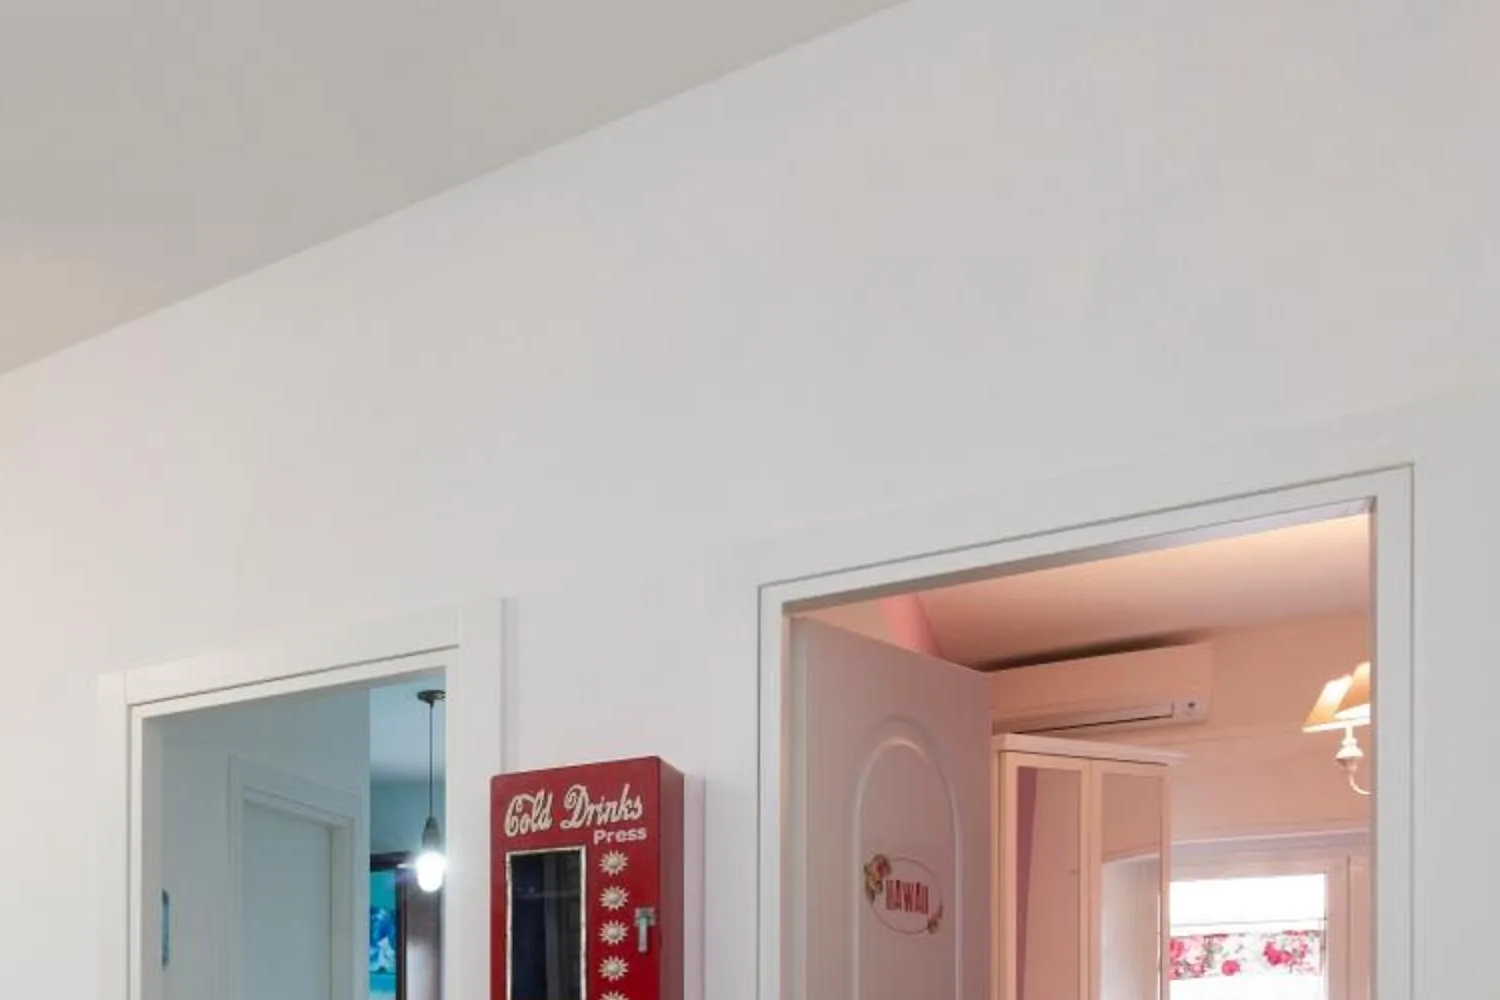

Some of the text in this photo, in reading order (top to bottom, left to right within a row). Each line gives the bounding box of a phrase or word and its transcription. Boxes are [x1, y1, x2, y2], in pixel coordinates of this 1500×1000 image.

[504, 783, 643, 837] Cold Drinks
[593, 827, 647, 845] Press
